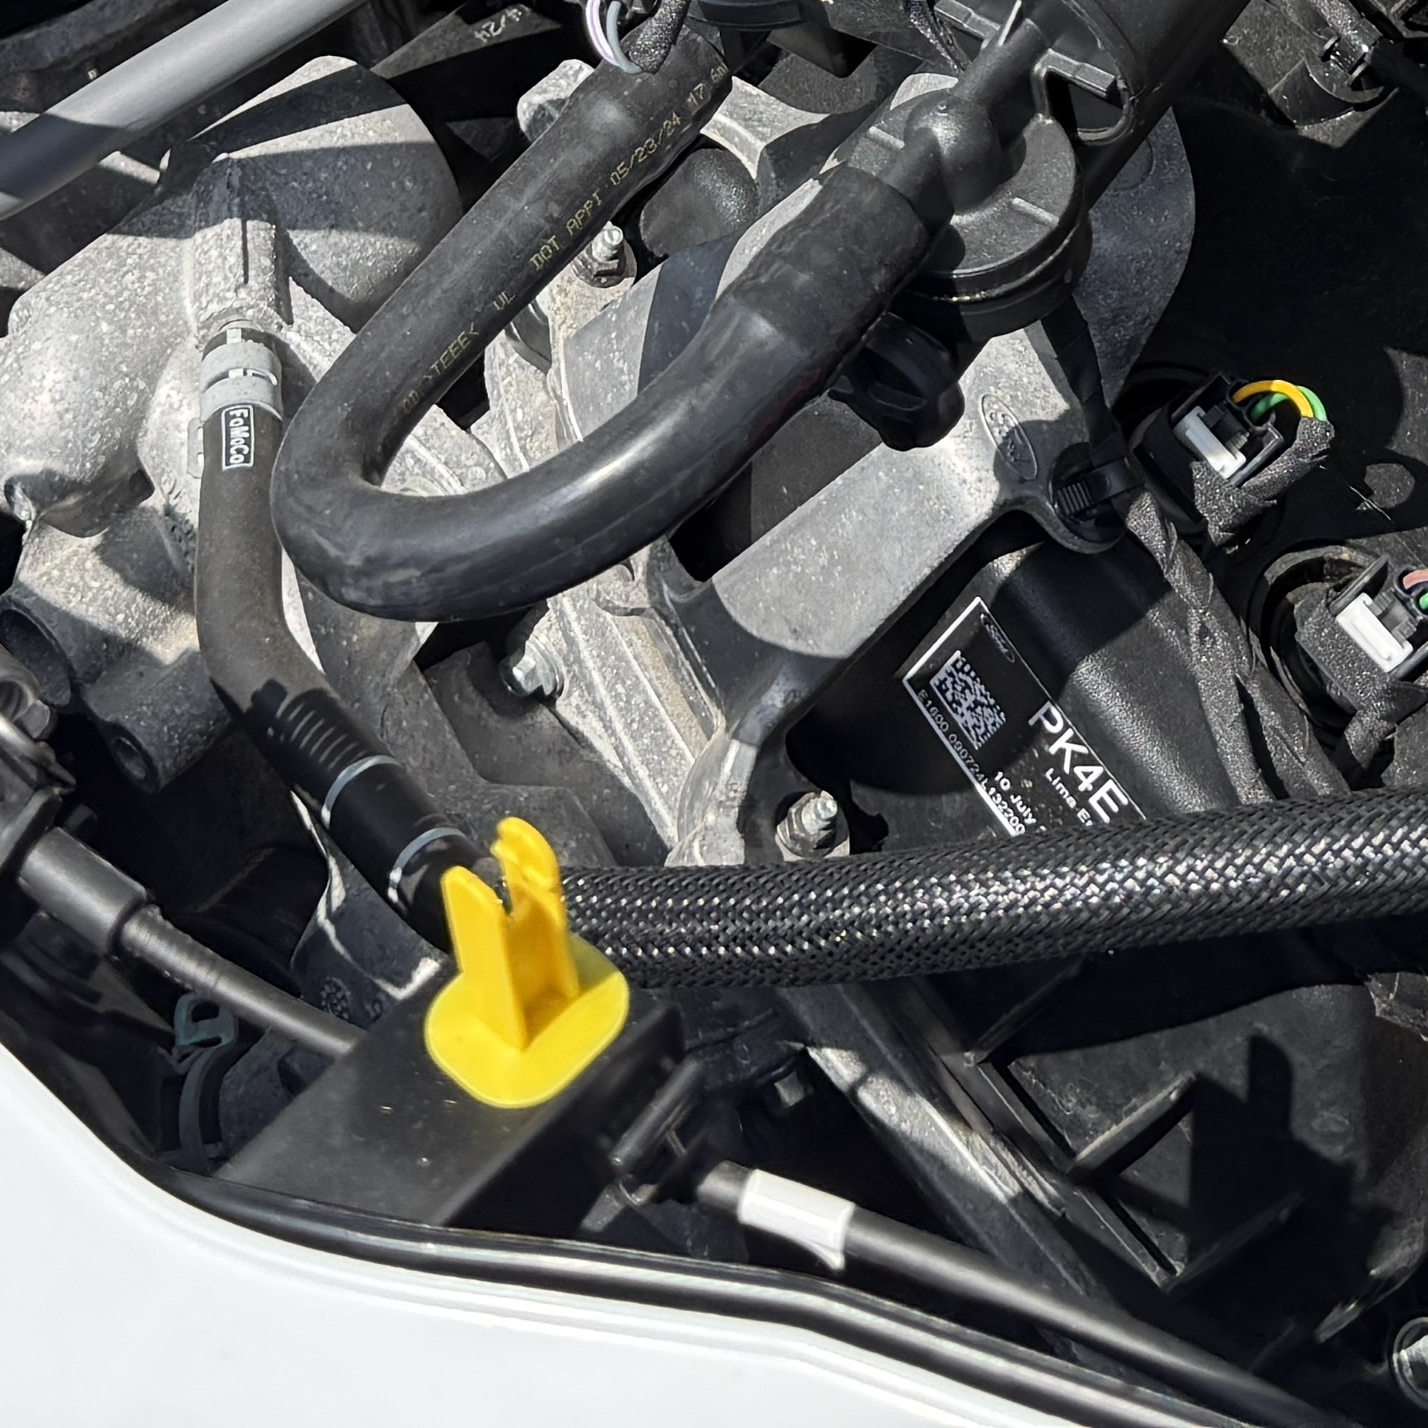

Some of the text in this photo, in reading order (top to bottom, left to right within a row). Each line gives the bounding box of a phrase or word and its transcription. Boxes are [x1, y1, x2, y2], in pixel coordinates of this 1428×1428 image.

[493, 291, 516, 312] UL
[528, 237, 563, 272] DOT
[565, 191, 603, 237] APPI
[609, 113, 682, 188] 05/23/24
[226, 407, 252, 467] FoMoCo
[1027, 699, 1130, 825] PK4E
[1044, 767, 1078, 810] Lima
[993, 771, 1037, 827] 10 July
